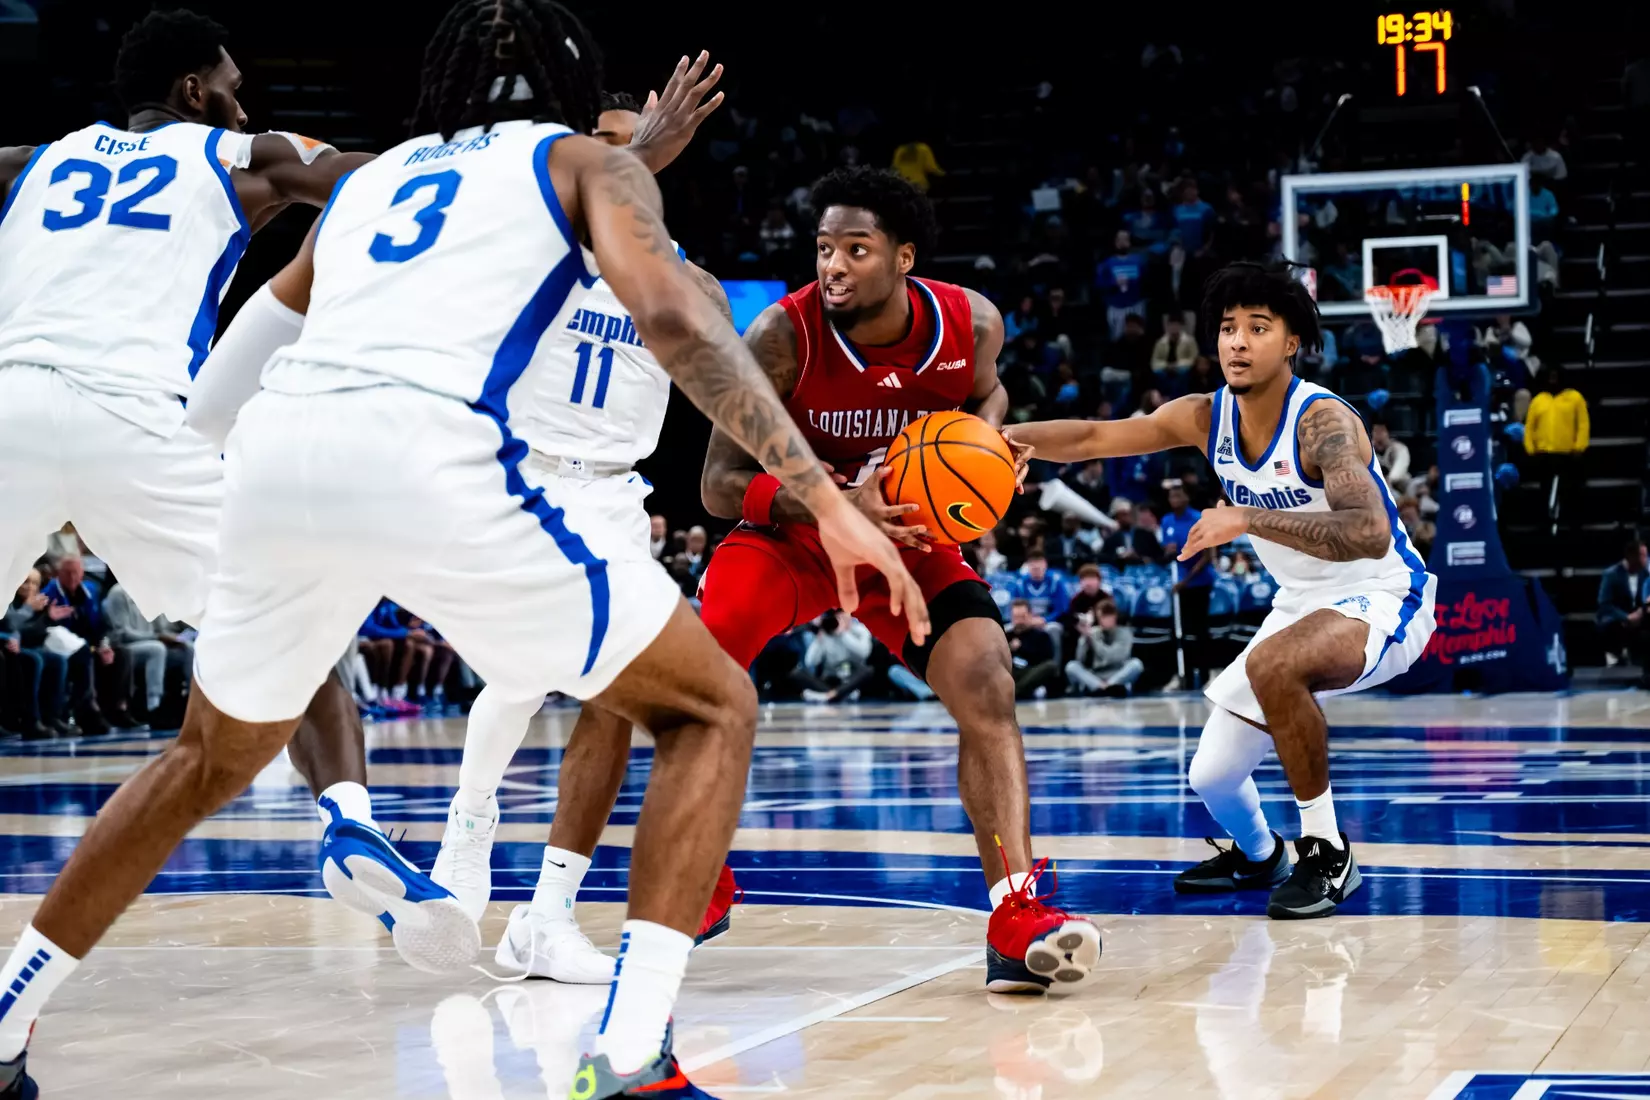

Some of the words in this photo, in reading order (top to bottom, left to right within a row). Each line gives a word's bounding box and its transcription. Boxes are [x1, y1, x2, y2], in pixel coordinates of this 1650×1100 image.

[1377, 11, 1452, 44] 19:34
[1396, 42, 1446, 96] 17
[94, 134, 152, 155] CISSE
[42, 154, 178, 232] 32
[367, 169, 462, 263] 3
[570, 341, 615, 409] 11
[808, 408, 909, 438] LOUISIANA
[1220, 474, 1312, 510] Memphis
